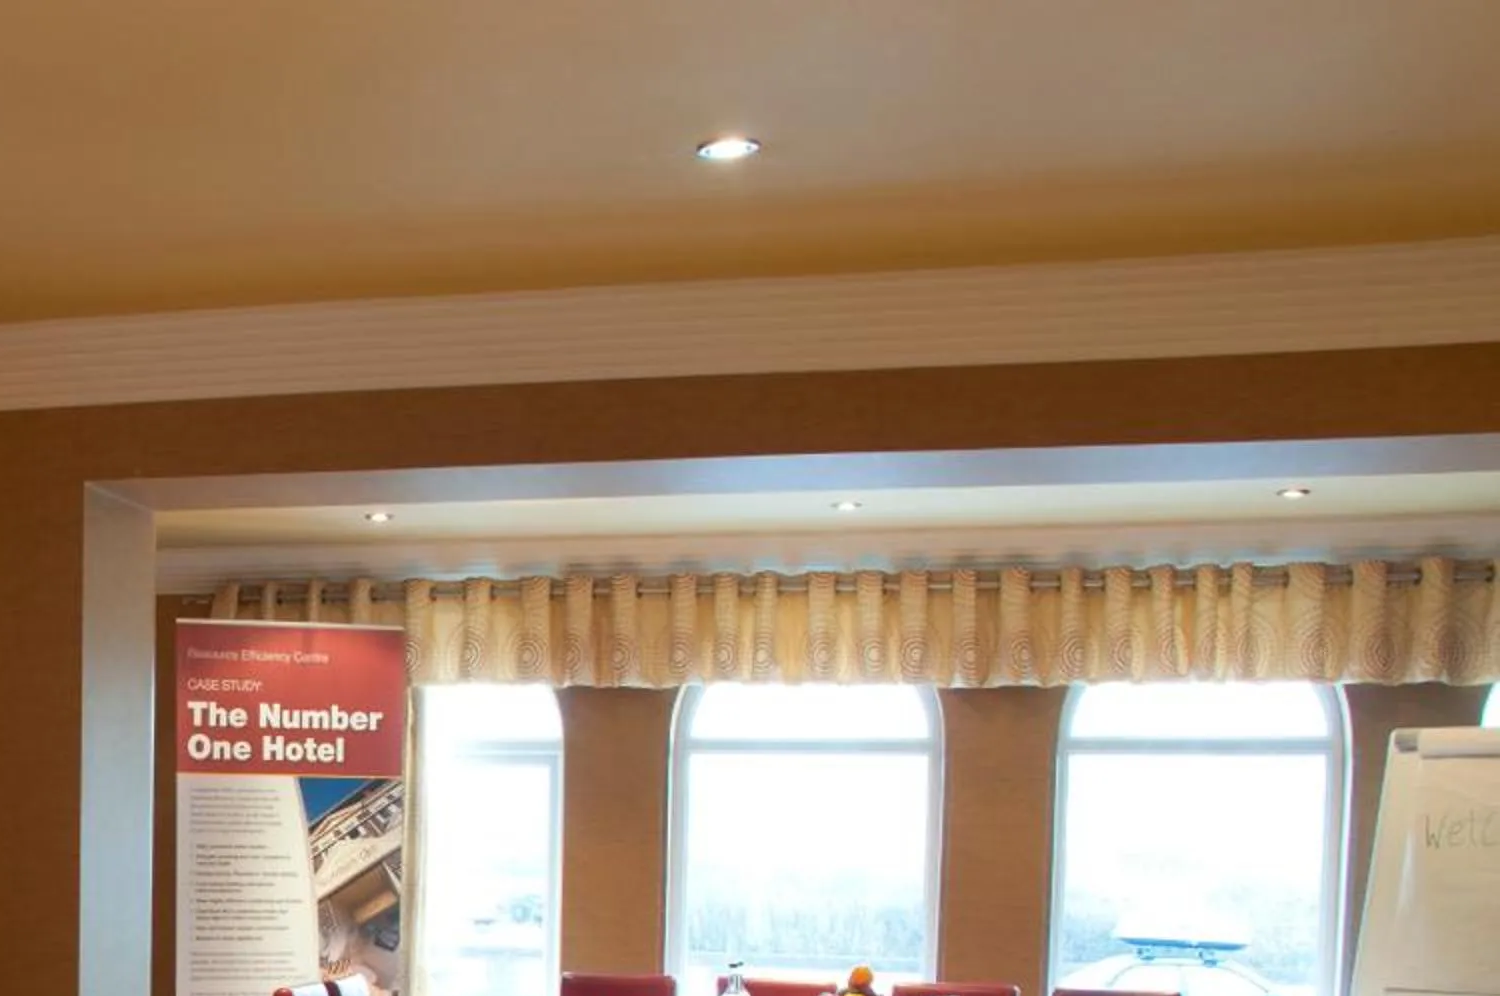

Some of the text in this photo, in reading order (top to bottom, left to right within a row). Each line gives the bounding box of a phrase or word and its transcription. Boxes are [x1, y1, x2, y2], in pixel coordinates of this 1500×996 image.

[187, 678, 219, 691] CASE
[187, 701, 384, 731] The Number
[187, 734, 345, 762] One Hotel
